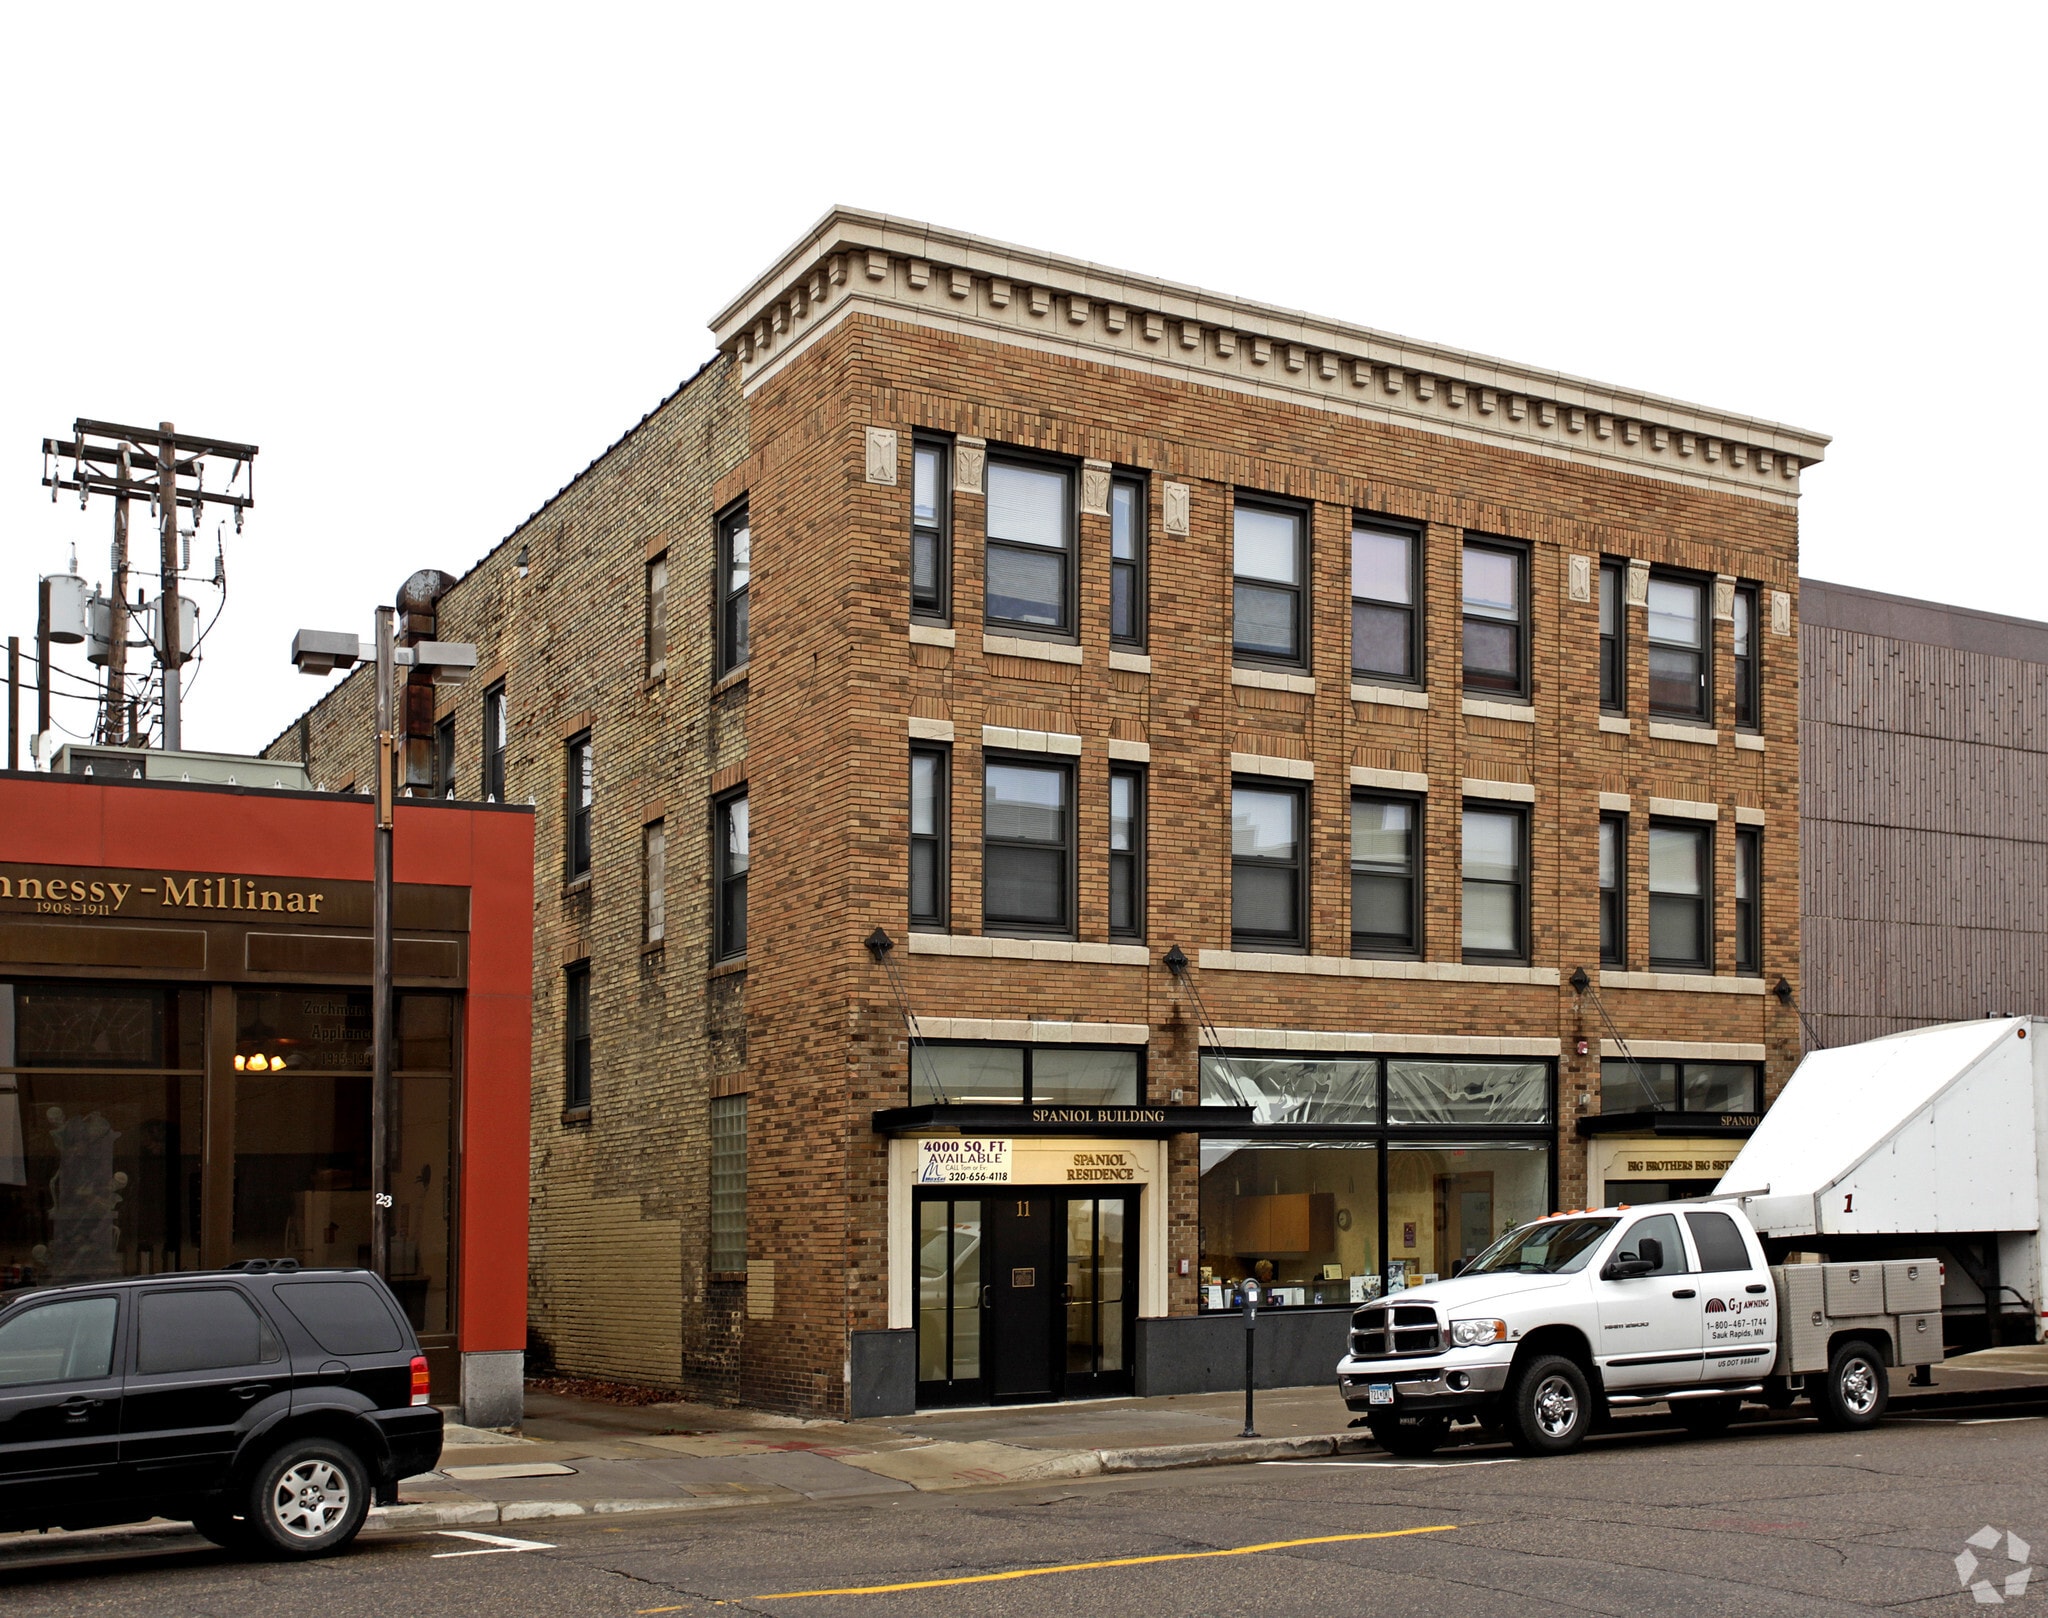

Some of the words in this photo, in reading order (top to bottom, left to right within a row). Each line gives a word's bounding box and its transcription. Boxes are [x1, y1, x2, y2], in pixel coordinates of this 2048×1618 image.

[162, 876, 324, 914] Millinar
[36, 901, 110, 916] 1908-1911
[304, 1000, 365, 1015] Zachman
[321, 1053, 373, 1065] 1935-193
[1032, 1109, 1094, 1122] SPANIOL
[1098, 1110, 1165, 1123] BUILDING
[923, 1141, 960, 1153] 4000
[964, 1140, 985, 1154] SQ.
[989, 1141, 1007, 1152] FT.
[929, 1153, 1002, 1164] AVAILABLE
[1073, 1154, 1127, 1166] SPANIOL
[1628, 1161, 1643, 1171] BIG
[1646, 1160, 1693, 1171] BROTHERS
[1695, 1160, 1710, 1171] BIG
[948, 1172, 1008, 1181] 320-656-4118
[1066, 1168, 1134, 1181] RESIDENCE
[375, 1192, 392, 1208] 23
[1843, 1193, 1853, 1213] 1
[1016, 1200, 1031, 1217] 11
[1743, 1299, 1769, 1309] AWNING
[1706, 1318, 1767, 1330] 1-800-467-1744
[1712, 1331, 1728, 1340] Sauk
